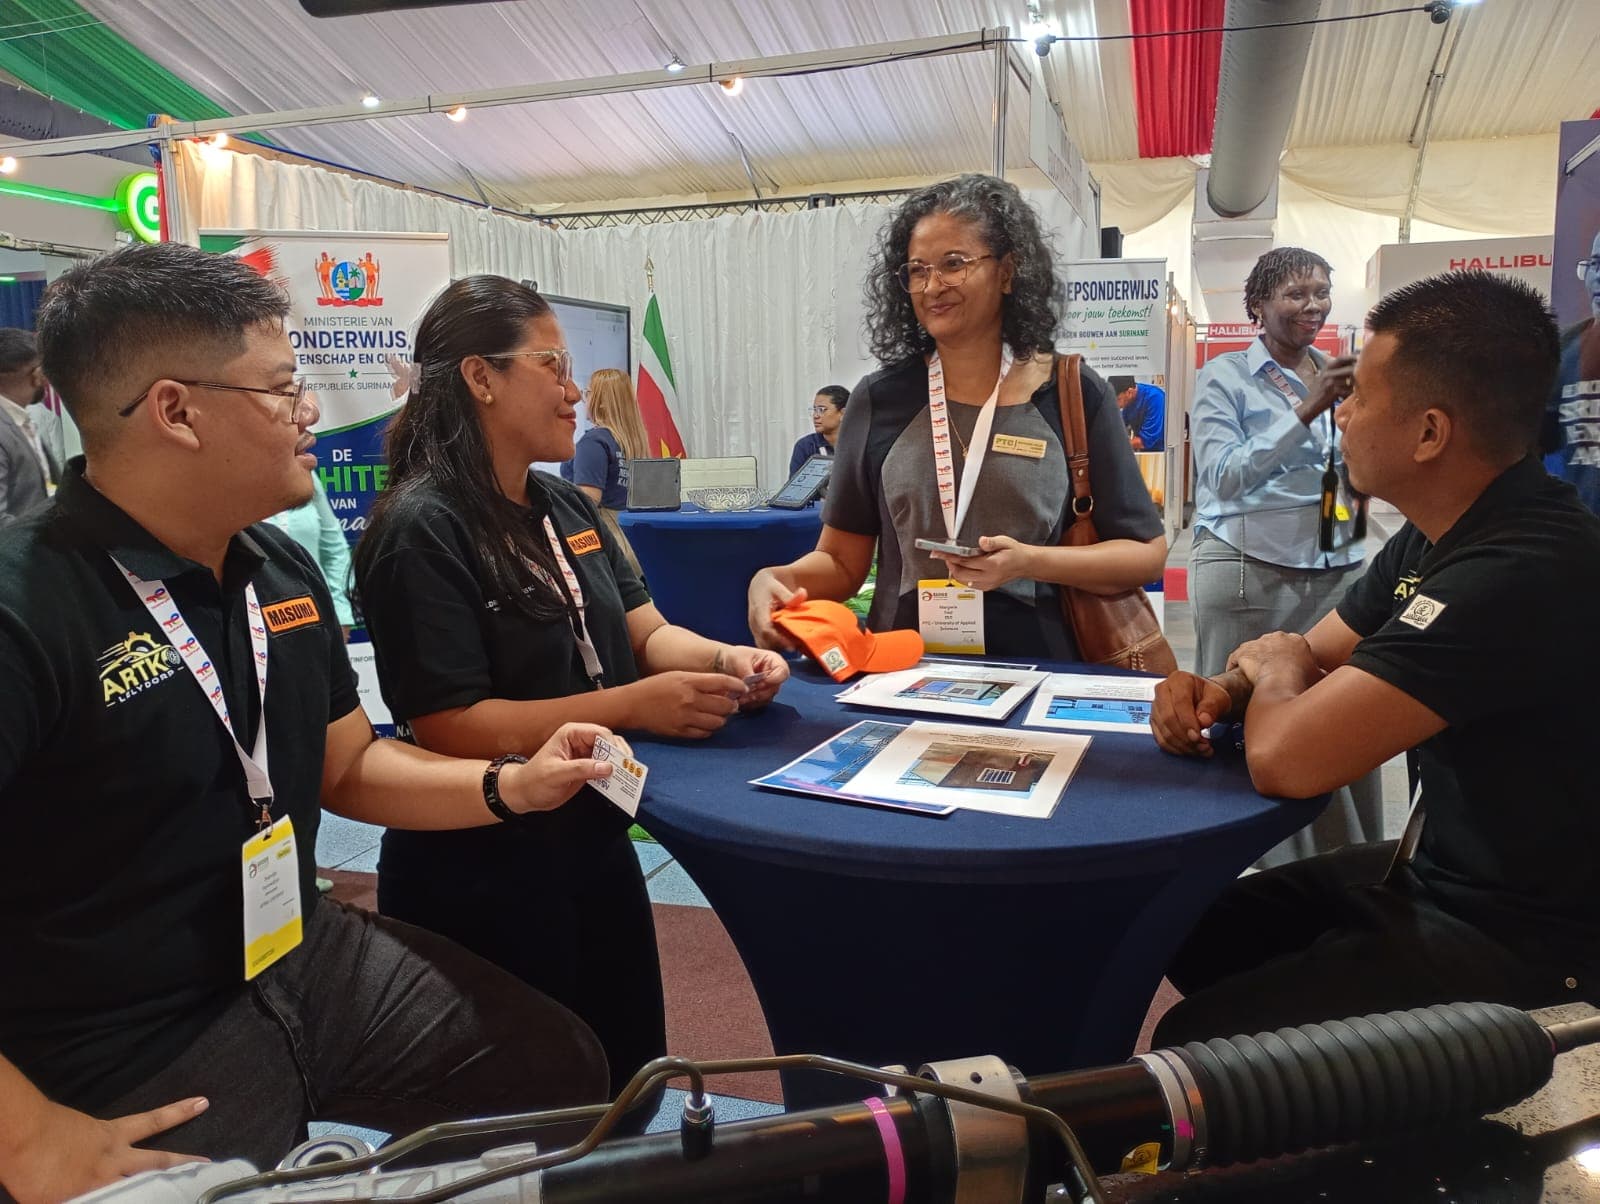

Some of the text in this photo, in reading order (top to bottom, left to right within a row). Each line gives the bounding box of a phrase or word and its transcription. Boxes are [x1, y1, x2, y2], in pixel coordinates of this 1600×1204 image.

[1082, 307, 1105, 323] jouw
[1108, 303, 1153, 319] toekomst!
[304, 316, 393, 328] MINISTERIE VAN
[1105, 330, 1118, 338] AAN
[1119, 329, 1150, 338] SURINAME
[288, 330, 412, 351] ONDERWIJS,
[359, 353, 374, 364] EN
[307, 382, 354, 391] REPUBLIEK
[332, 449, 353, 462] DE
[330, 498, 357, 510] VAN
[266, 602, 316, 627] MASUMA
